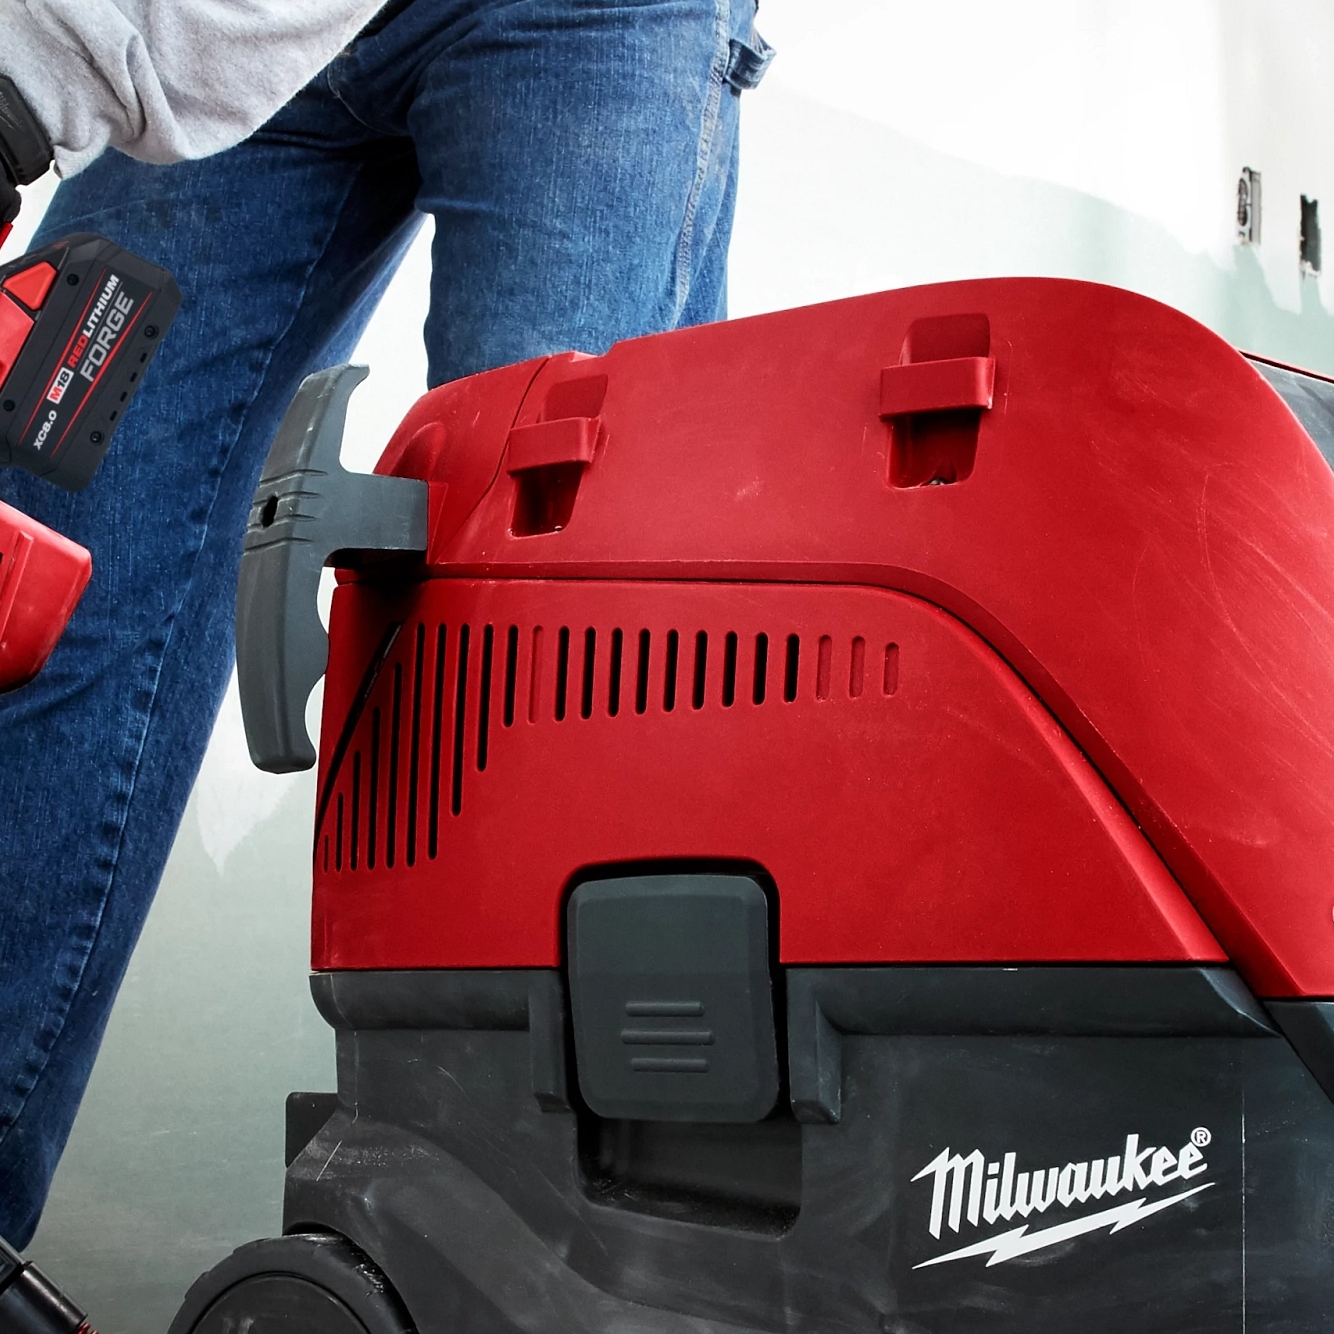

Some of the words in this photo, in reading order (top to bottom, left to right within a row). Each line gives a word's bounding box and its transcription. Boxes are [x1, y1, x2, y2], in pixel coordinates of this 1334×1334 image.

[48, 369, 71, 403] M18
[67, 273, 120, 369] REDLITHIUM
[79, 291, 135, 383] FORGE
[33, 410, 58, 451] XC8.0
